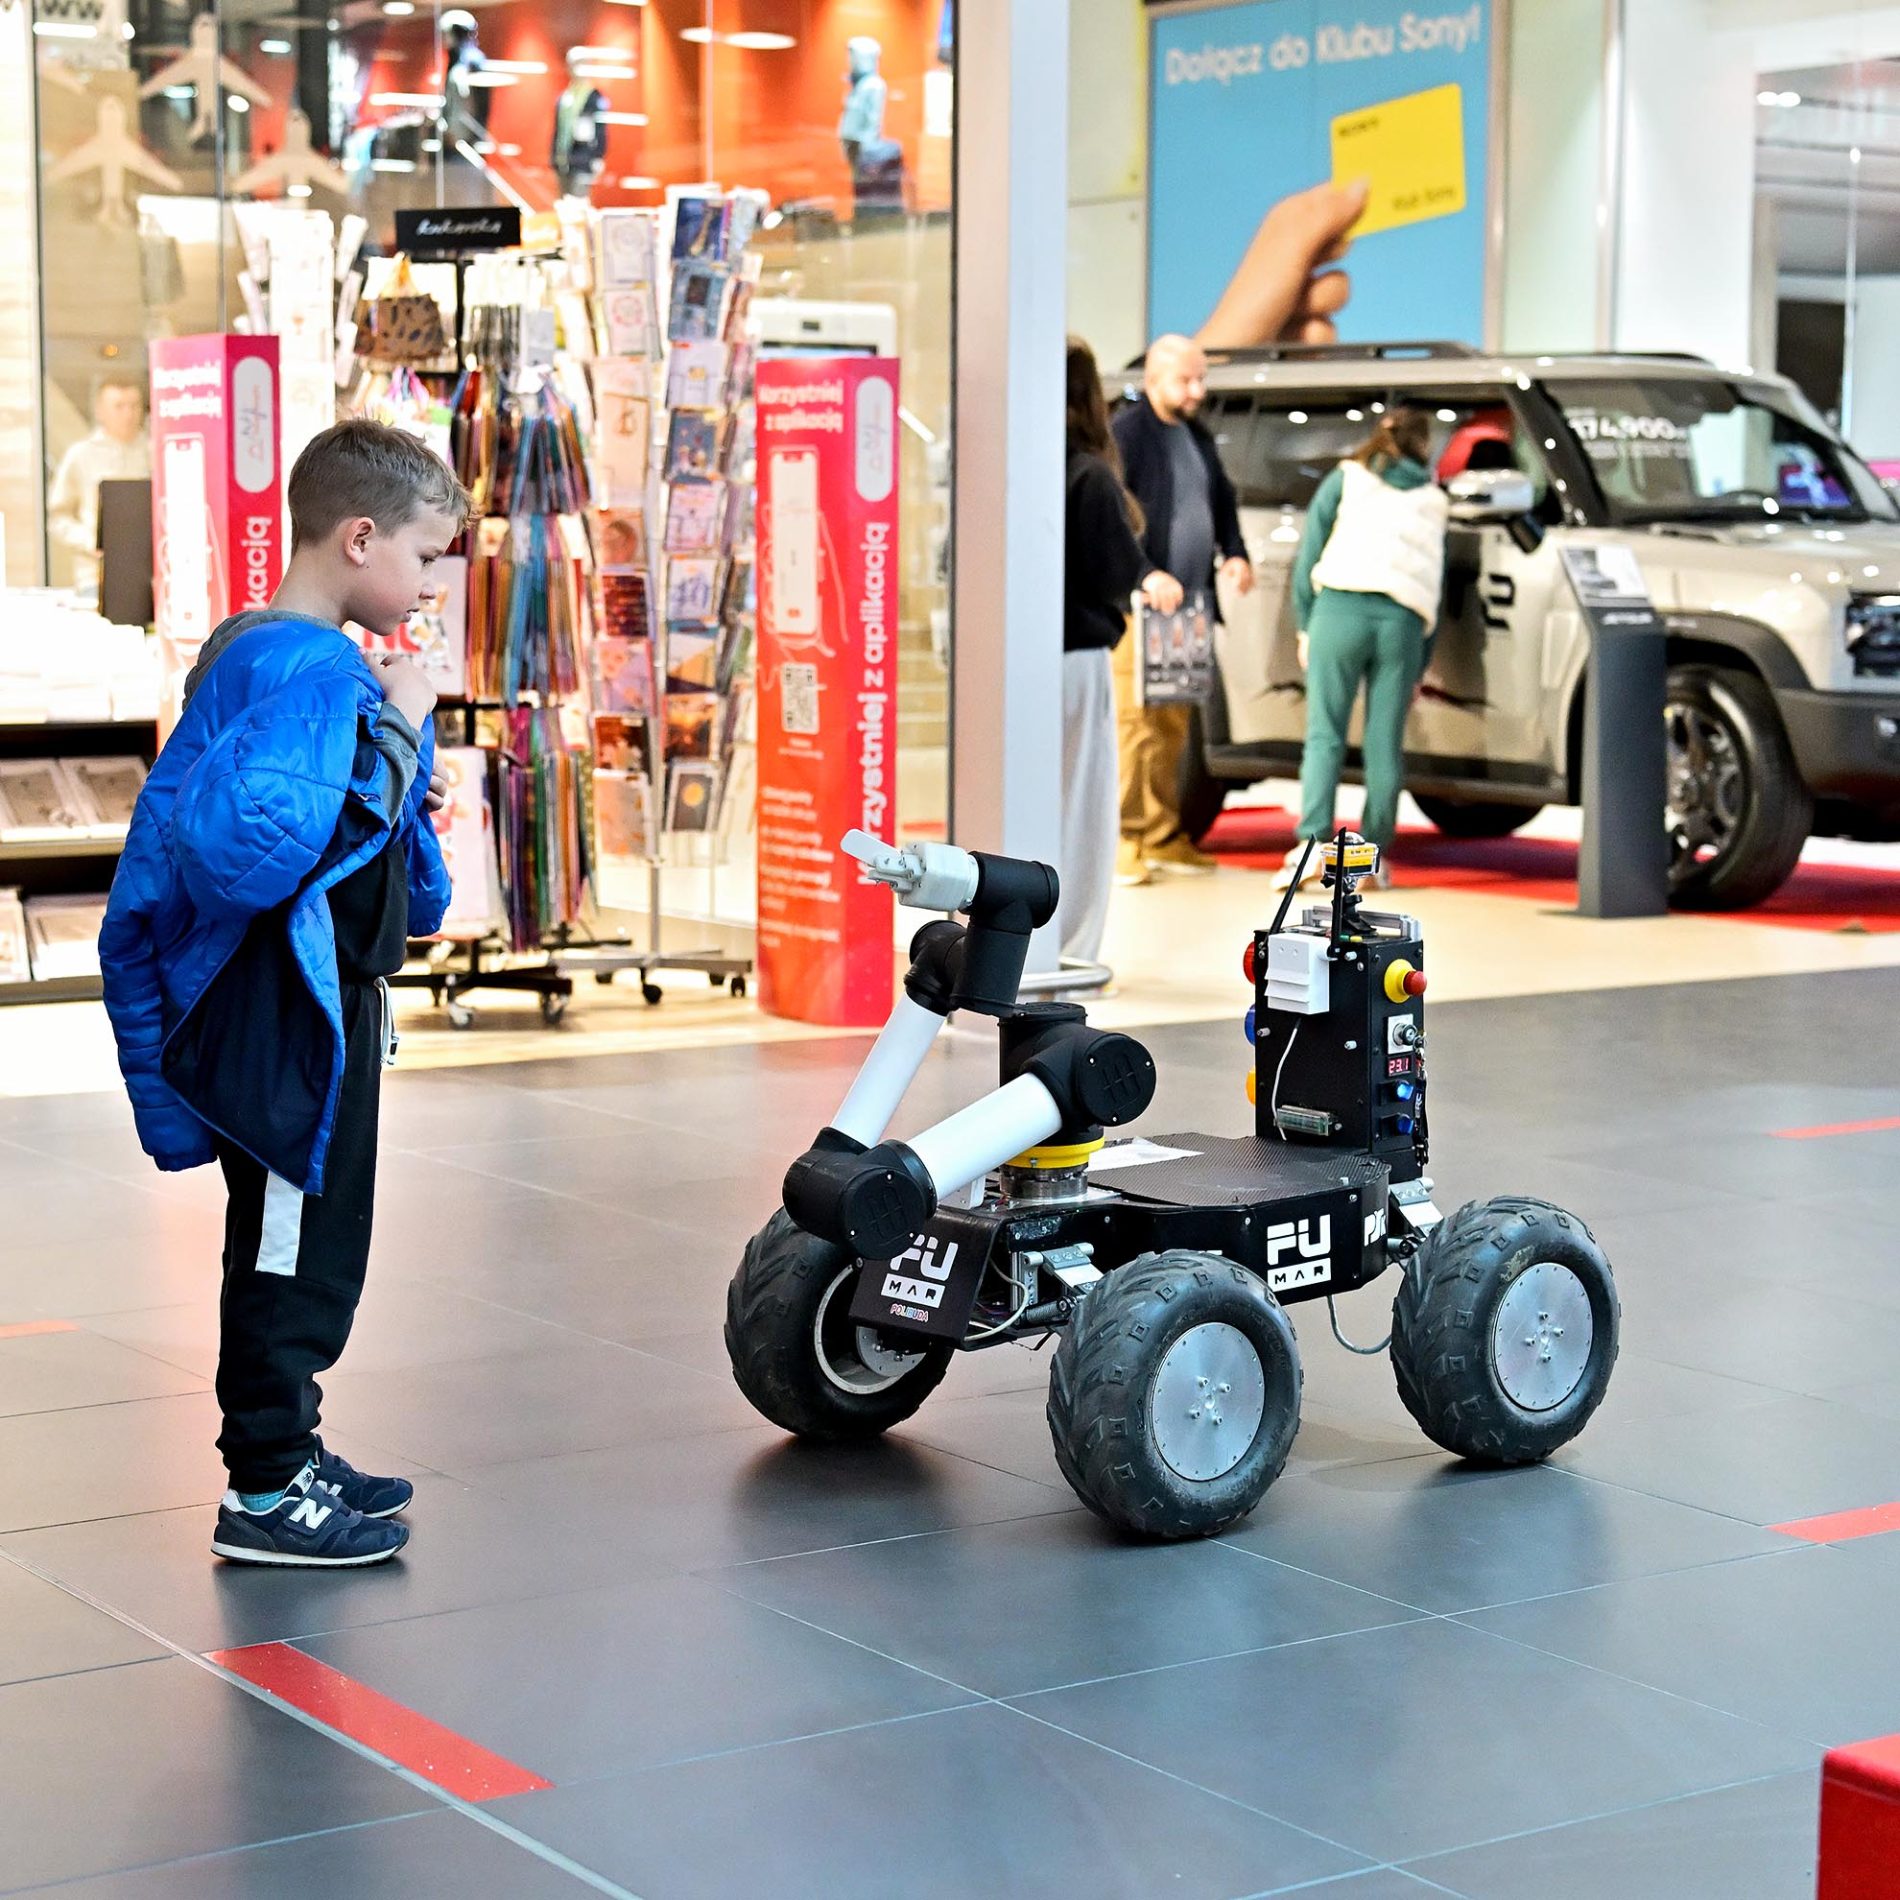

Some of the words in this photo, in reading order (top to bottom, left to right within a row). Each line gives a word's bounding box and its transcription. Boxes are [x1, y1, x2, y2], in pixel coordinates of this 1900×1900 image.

[1165, 43, 1262, 86] Dołącz
[1268, 34, 1310, 70] do
[1316, 22, 1395, 64] Klubu
[1400, 3, 1481, 53] Sony!
[859, 521, 890, 665] aplikacją
[864, 669, 883, 688] z
[857, 692, 888, 885] Krzystniej
[888, 1279, 937, 1301] MAR
[1274, 1264, 1324, 1285] MAR
[288, 1497, 333, 1531] N
